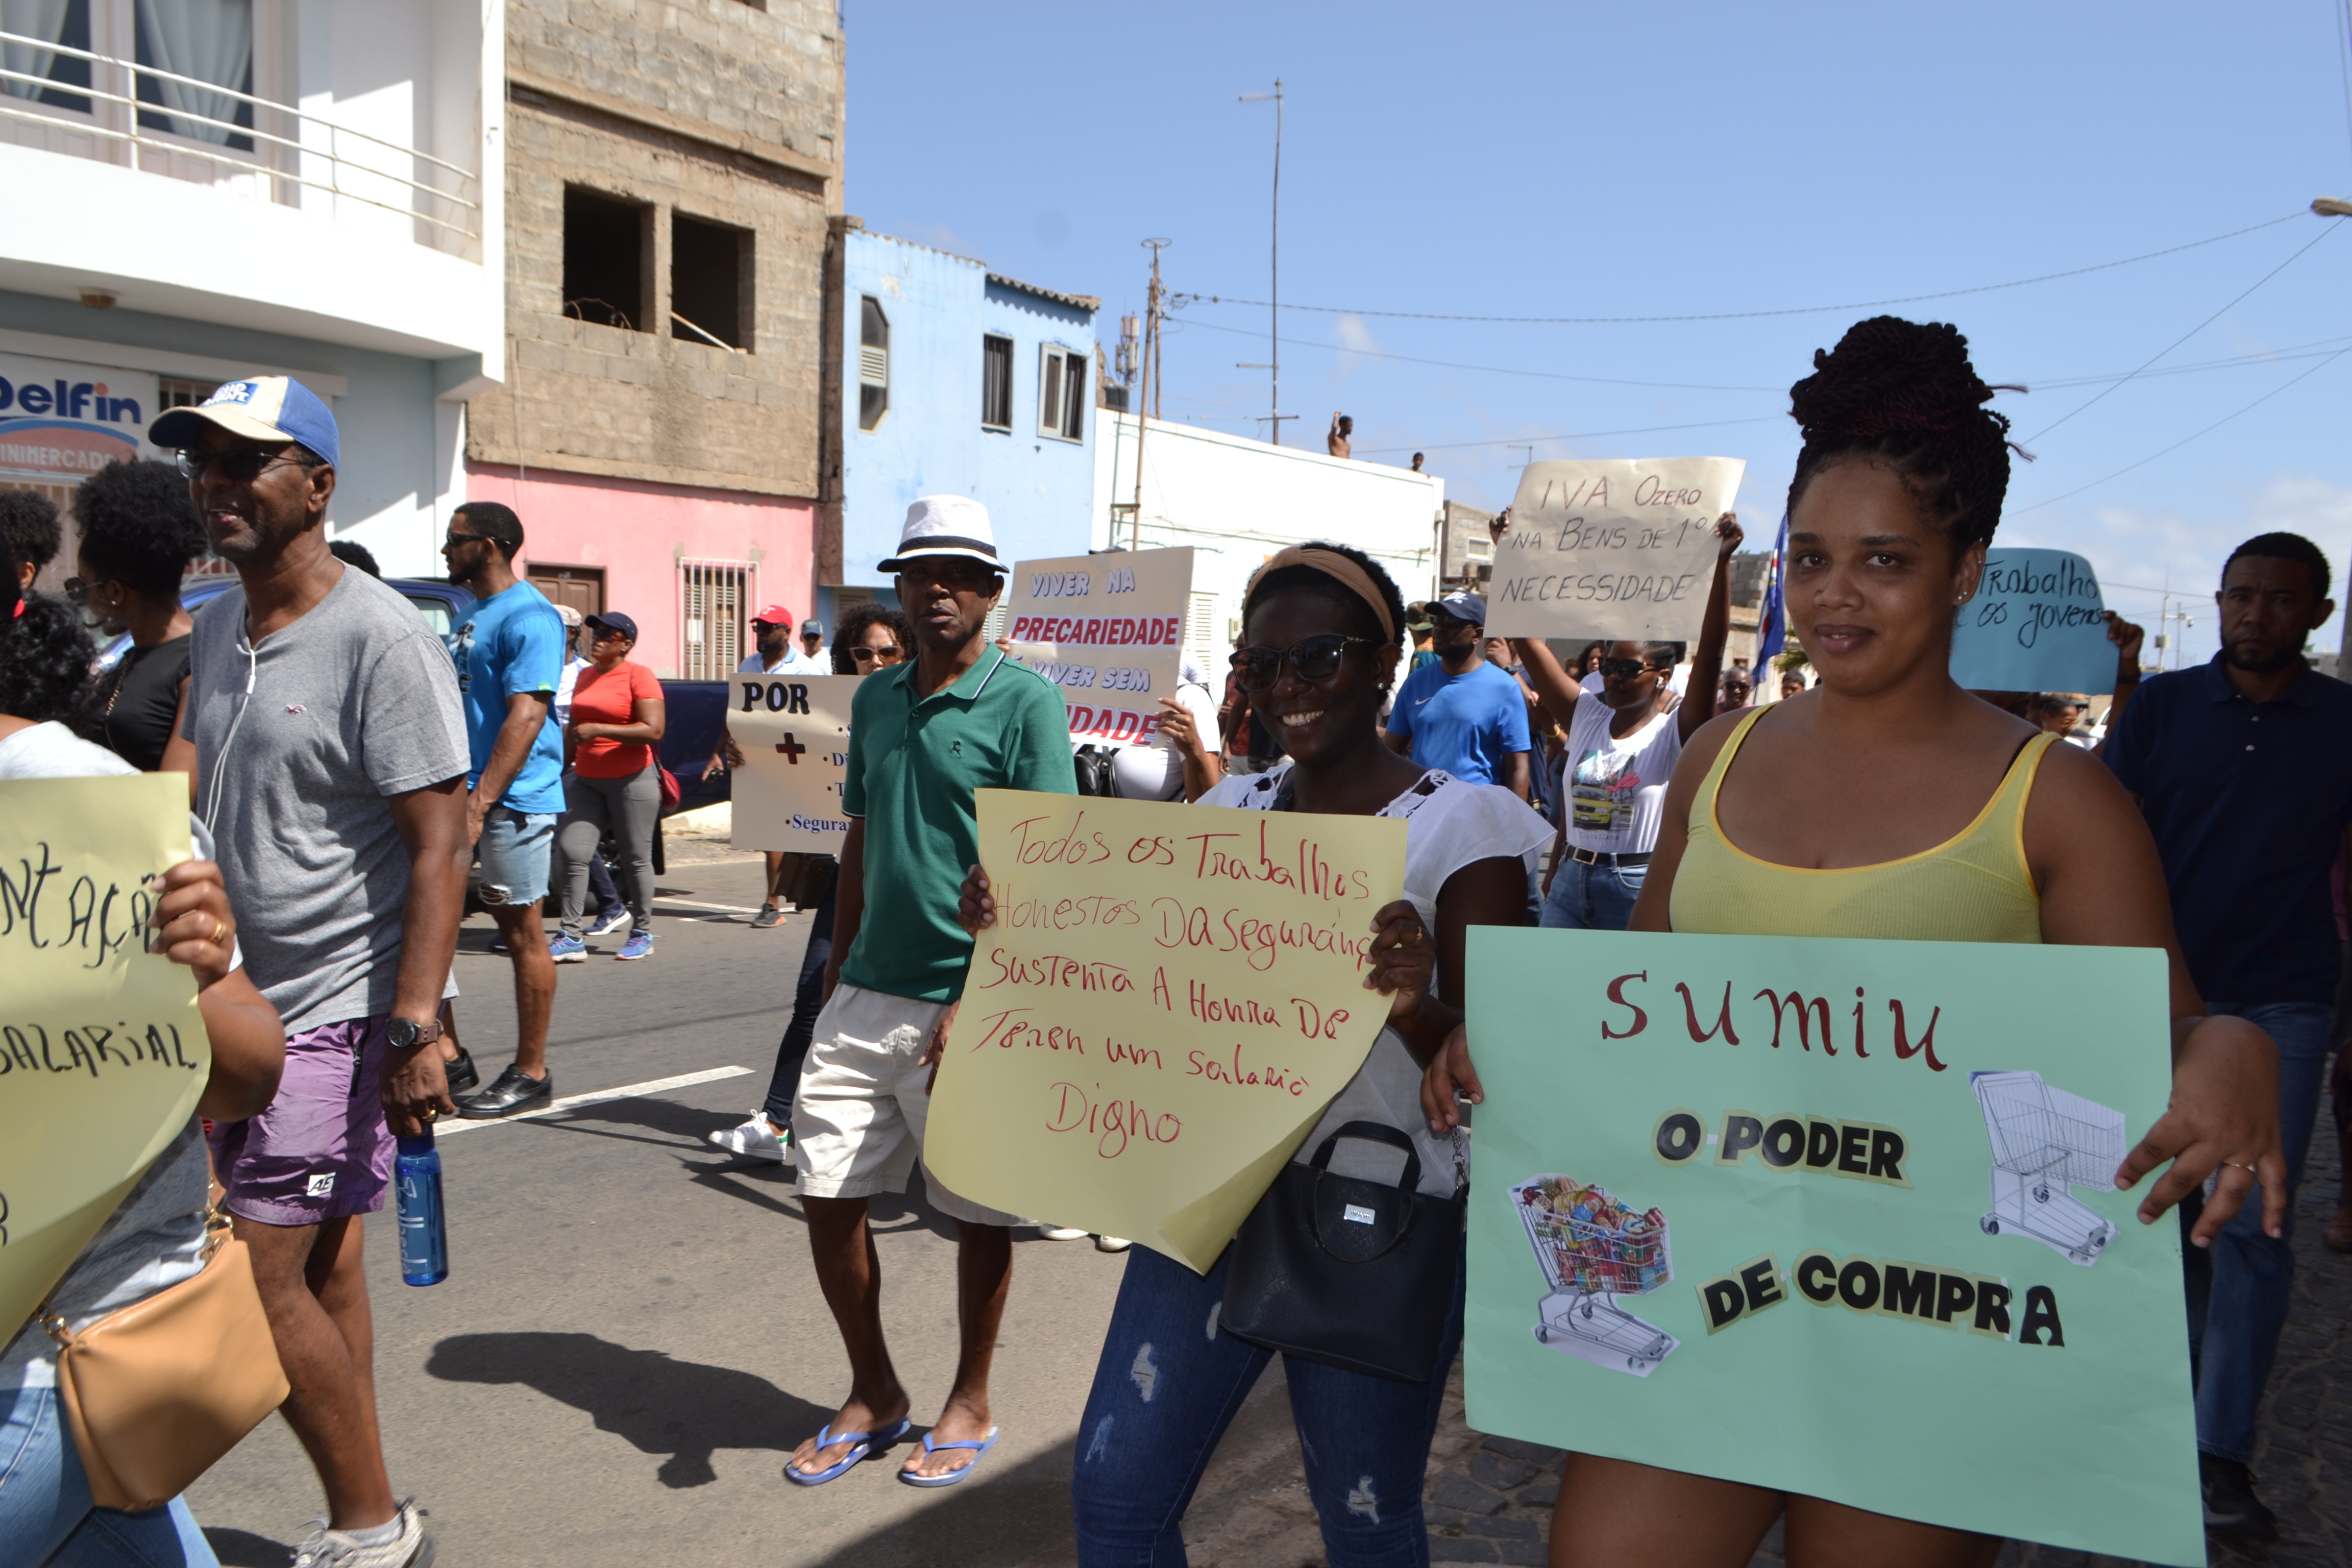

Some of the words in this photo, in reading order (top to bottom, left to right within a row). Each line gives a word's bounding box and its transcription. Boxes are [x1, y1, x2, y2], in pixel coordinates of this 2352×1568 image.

[1540, 475, 1608, 510] IVA
[1511, 531, 1541, 550] NA
[1557, 517, 1627, 551] BENS
[1637, 528, 1666, 549] DE
[1031, 572, 1090, 597] VIVER
[1107, 567, 1136, 594] NA
[1500, 574, 1696, 603] NECESSIDADE
[1010, 617, 1180, 645] PRECARIEDADE
[1031, 660, 1096, 687] VIVER
[1101, 667, 1150, 692] SEM
[741, 681, 811, 715] POR
[792, 814, 851, 834] Segura
[1011, 811, 1110, 864] Todos
[1186, 819, 1370, 900] Trabalhos
[1107, 1037, 1162, 1070] um
[1045, 1082, 1184, 1158] Digno
[1656, 1113, 1701, 1161] O
[1721, 1115, 1904, 1181] PODER
[1704, 1258, 1783, 1328] DE
[1798, 1255, 2065, 1348] COMPRA
